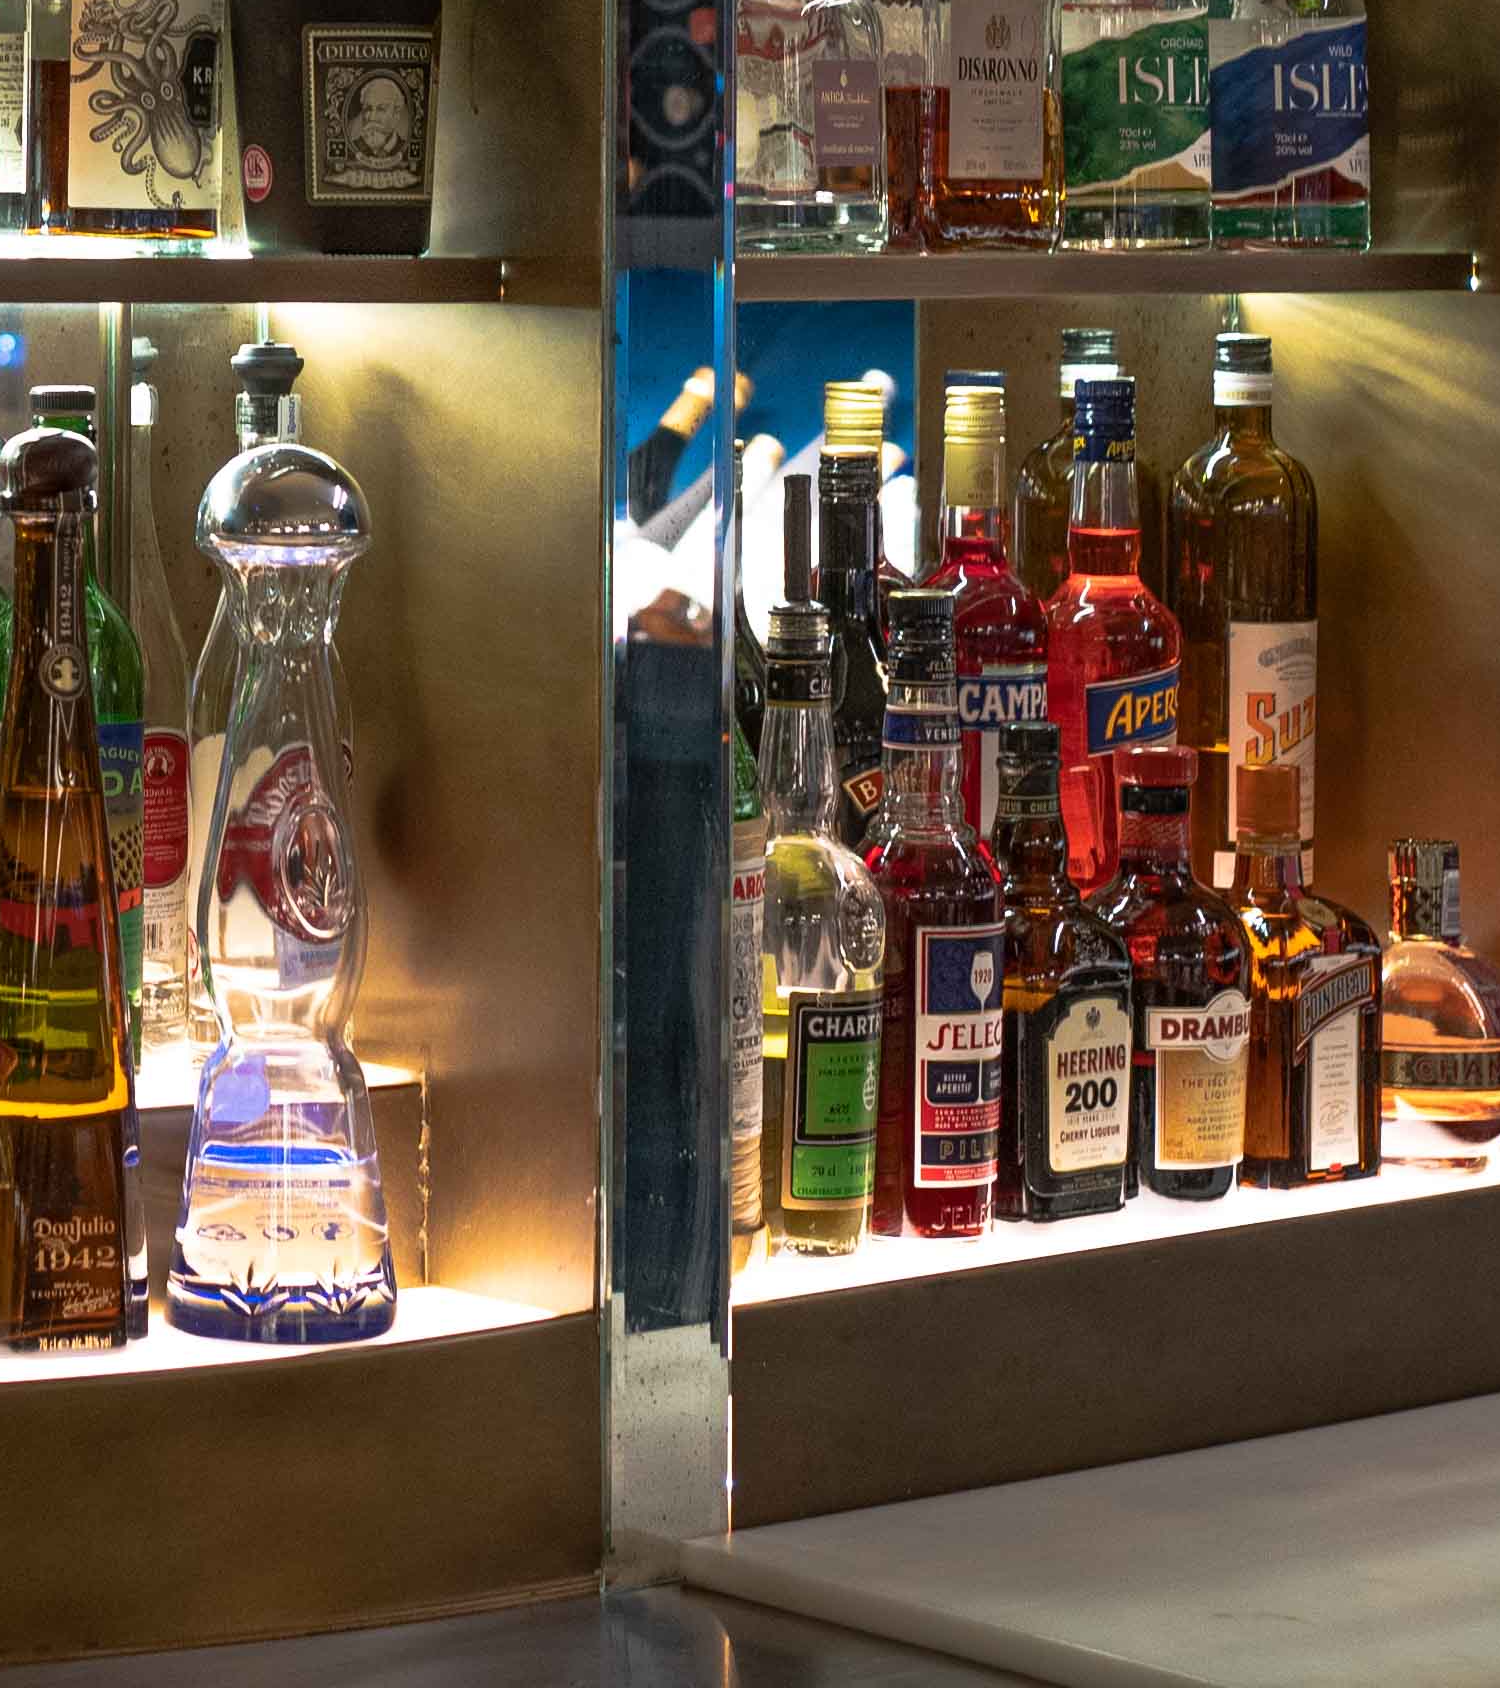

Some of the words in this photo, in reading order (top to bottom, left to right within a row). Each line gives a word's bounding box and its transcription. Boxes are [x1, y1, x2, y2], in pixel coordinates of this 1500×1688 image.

[1328, 45, 1353, 57] WILD
[958, 56, 1039, 84] DISARONNO
[59, 582, 74, 639] 1942
[1302, 967, 1369, 1035] COINTREAU
[1056, 1044, 1126, 1081] HEERING
[936, 1080, 974, 1097] APERITIF
[943, 1072, 968, 1083] BITTER
[1181, 1077, 1202, 1089] THE
[1064, 1076, 1119, 1113] 200
[1059, 1129, 1088, 1145] CHERRY
[1089, 1125, 1121, 1141] LIQUEUR
[34, 1244, 119, 1273] 1942
